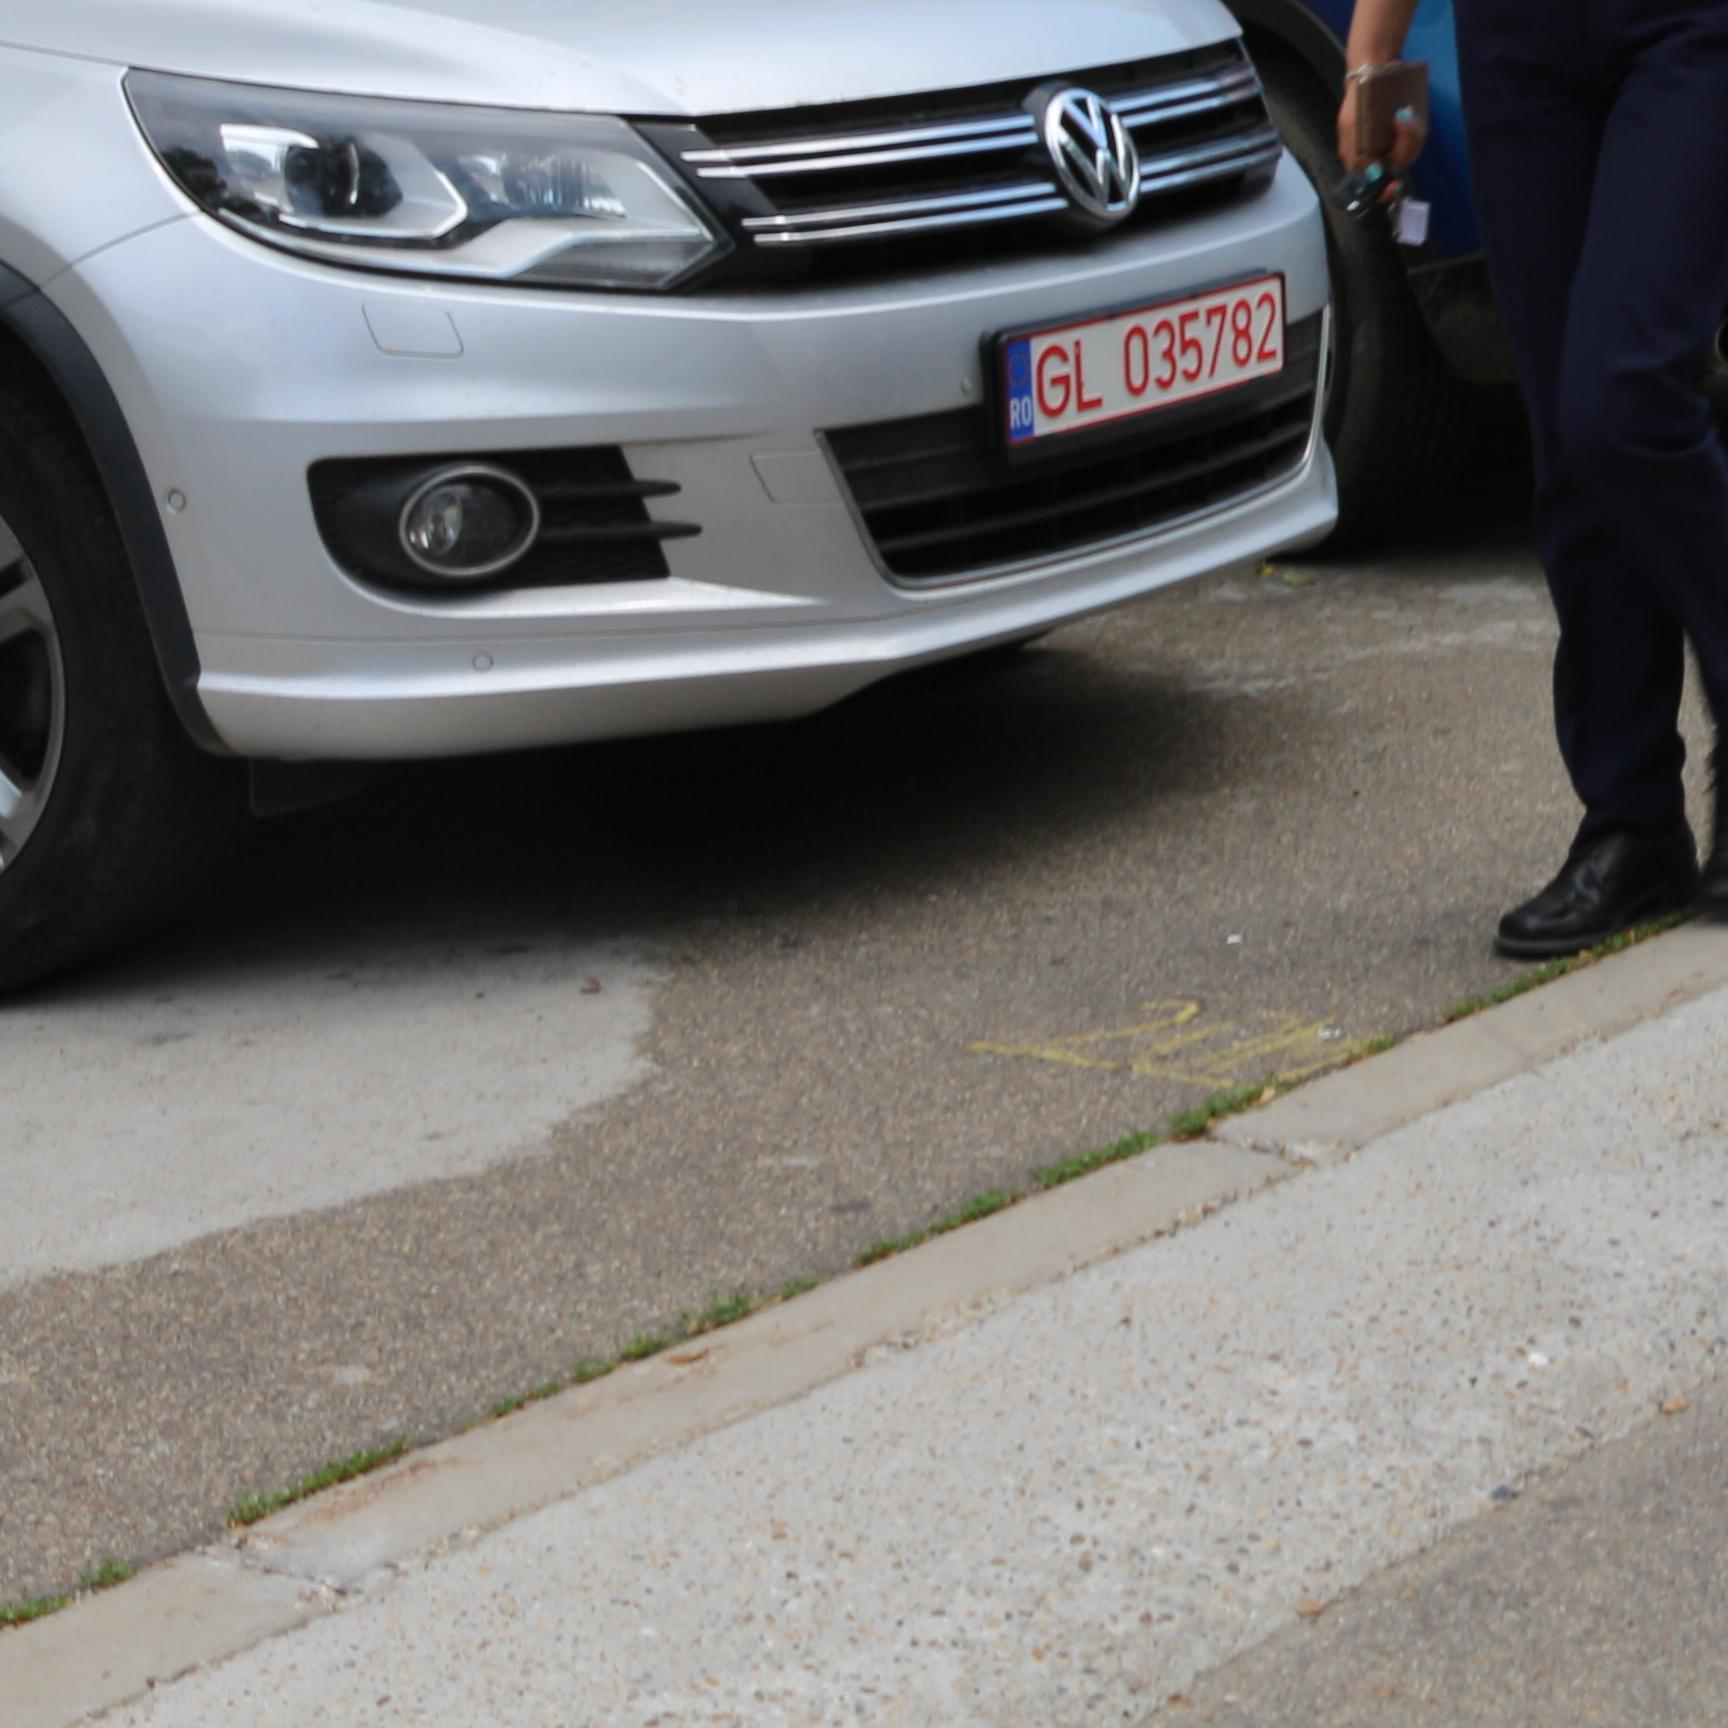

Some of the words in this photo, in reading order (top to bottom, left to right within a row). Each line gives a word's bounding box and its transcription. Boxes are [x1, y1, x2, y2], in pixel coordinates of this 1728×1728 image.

[1036, 340, 1102, 418] GL
[1124, 292, 1277, 397] 035782
[1010, 397, 1033, 430] RO
